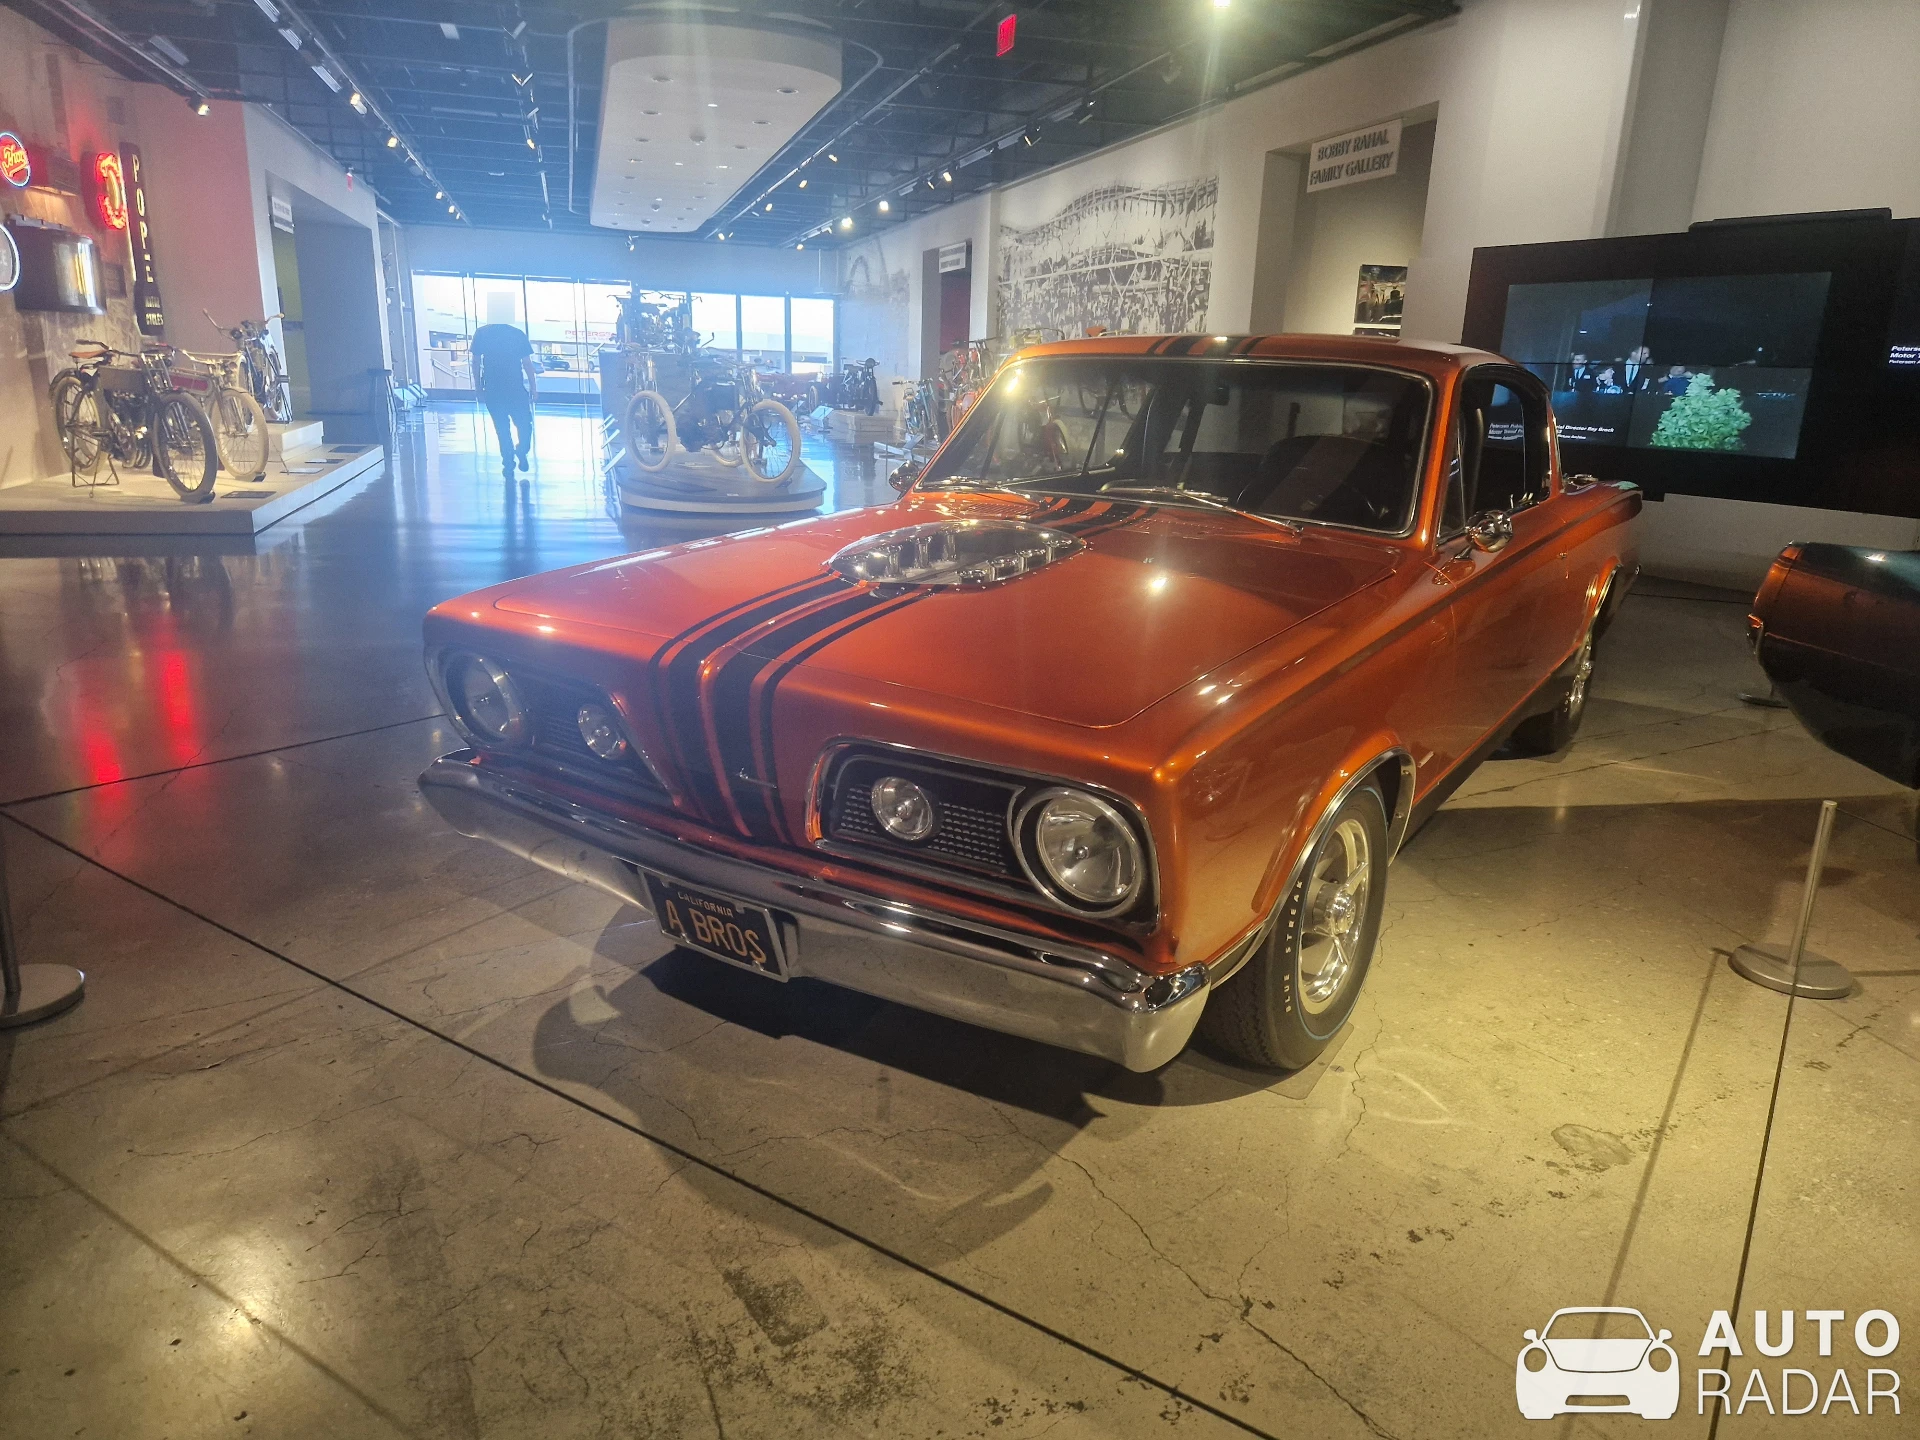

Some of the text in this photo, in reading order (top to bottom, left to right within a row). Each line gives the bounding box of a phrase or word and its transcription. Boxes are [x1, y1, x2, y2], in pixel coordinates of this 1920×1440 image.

[1309, 151, 1394, 185] FAMILY GALLERY
[1317, 128, 1389, 161] BOBBY RAHAL
[132, 154, 154, 283] POPE
[677, 891, 735, 918] CALIFORNIA
[665, 899, 767, 964] A BROS
[1283, 881, 1303, 1013] BLUE STREAK
